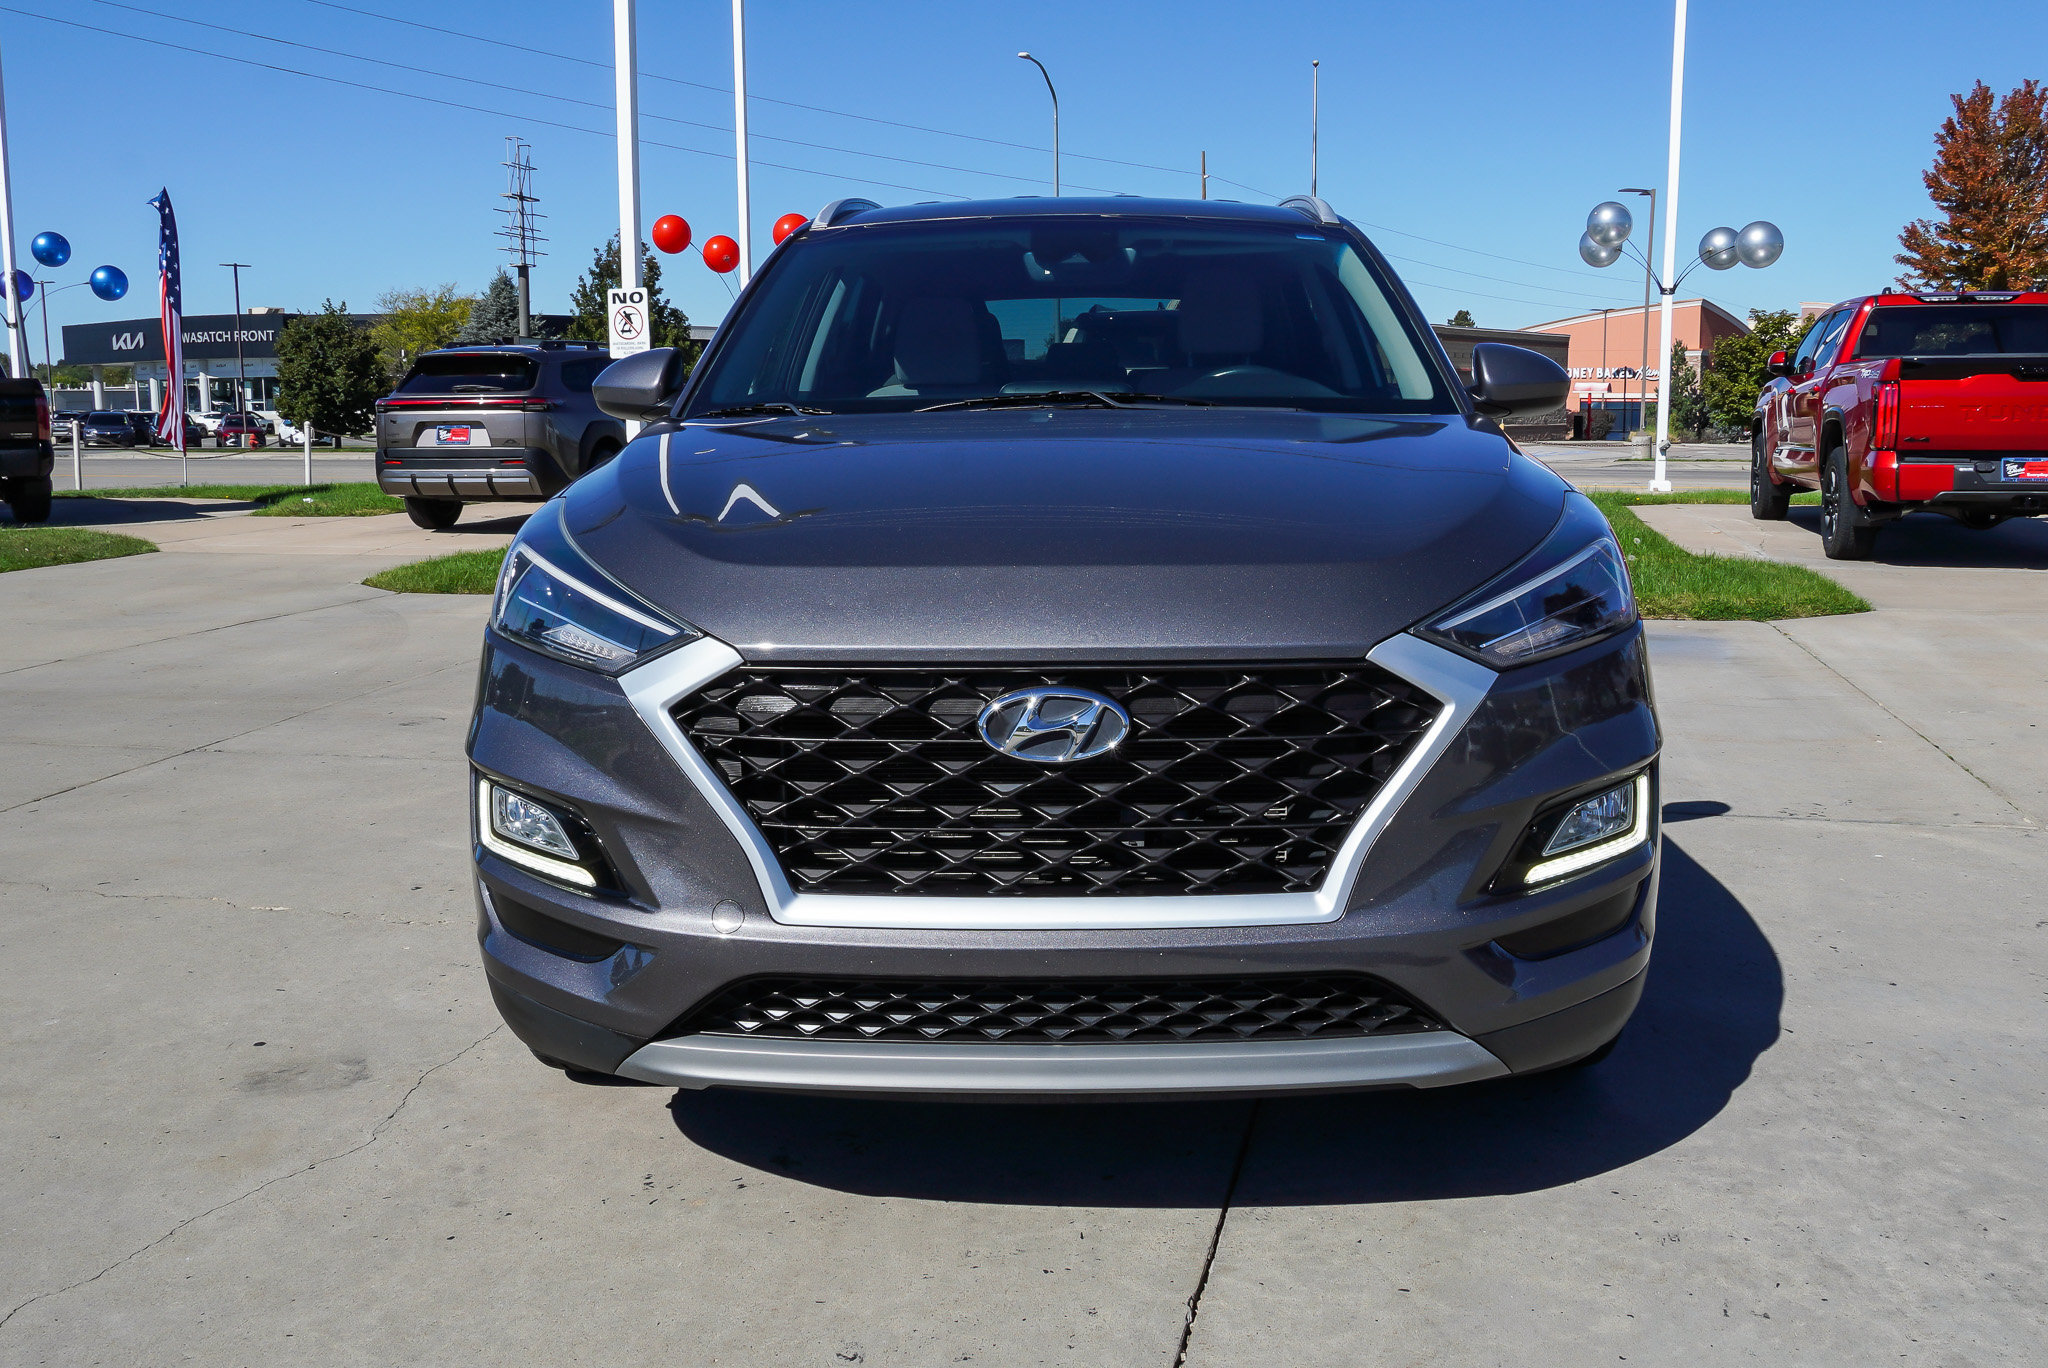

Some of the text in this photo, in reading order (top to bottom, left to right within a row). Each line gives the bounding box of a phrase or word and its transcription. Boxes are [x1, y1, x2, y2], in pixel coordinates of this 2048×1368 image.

[612, 292, 643, 304] NO
[112, 332, 144, 350] KIA
[182, 330, 274, 343] WASATCH FRONT
[1567, 367, 1593, 379] ONEY
[1596, 367, 1633, 379] BAKED
